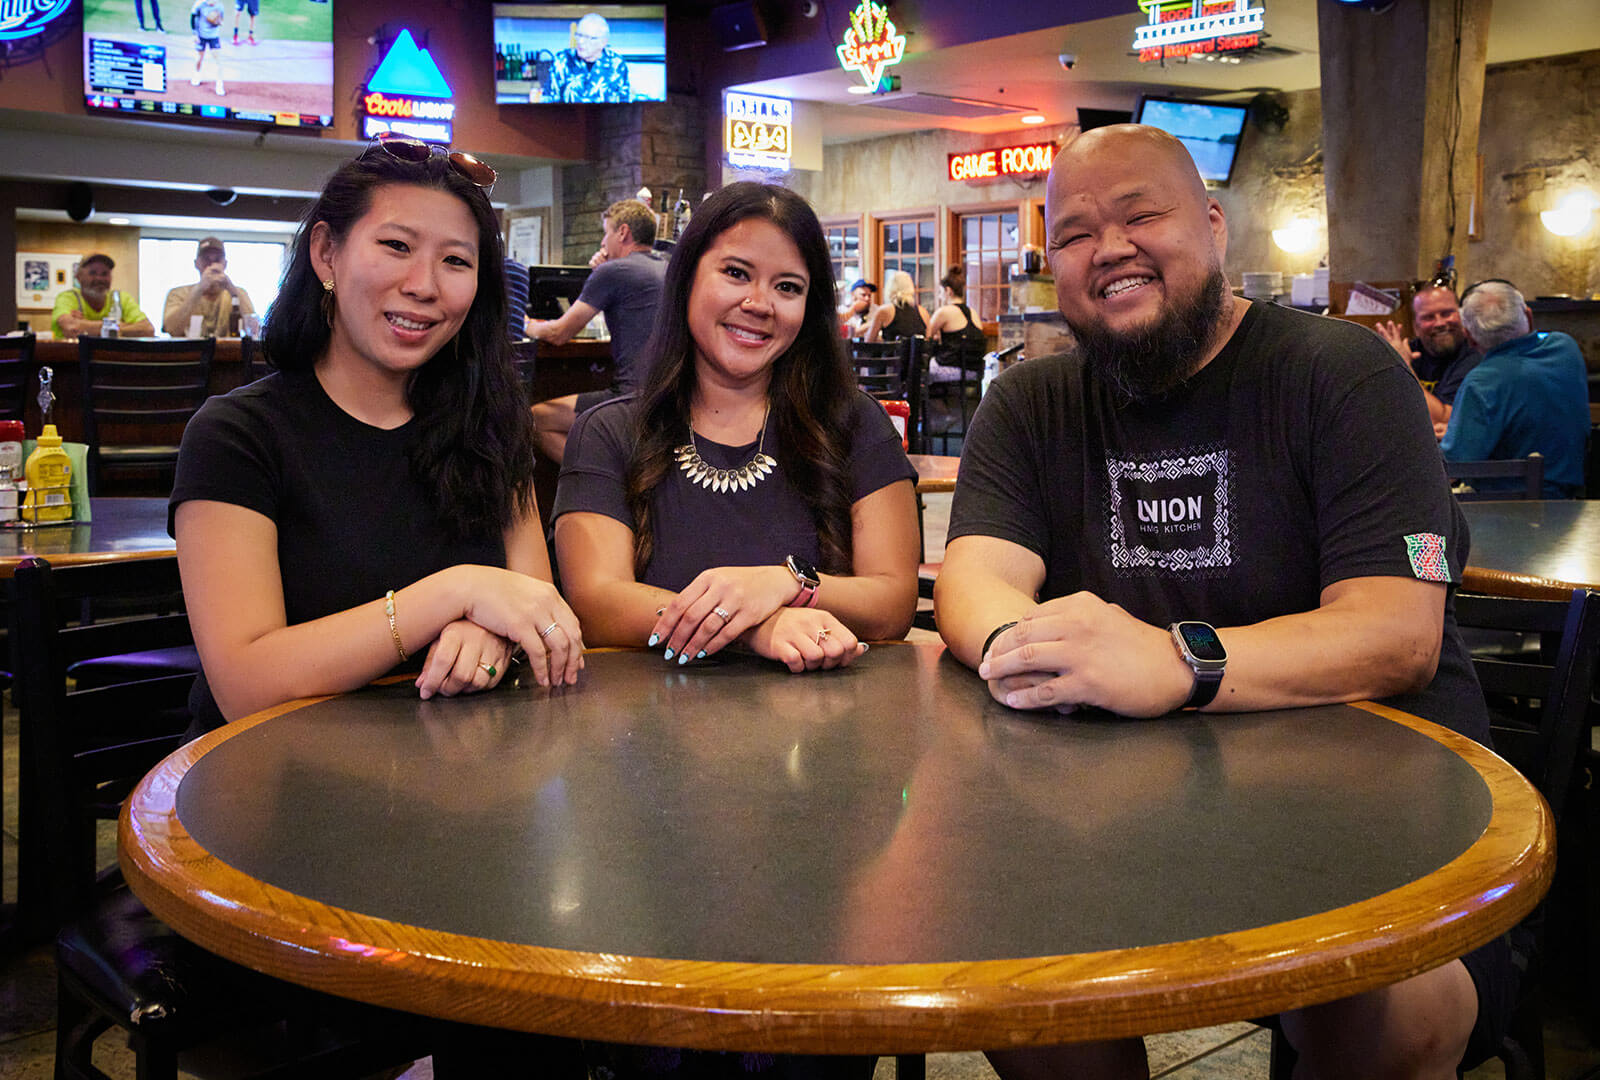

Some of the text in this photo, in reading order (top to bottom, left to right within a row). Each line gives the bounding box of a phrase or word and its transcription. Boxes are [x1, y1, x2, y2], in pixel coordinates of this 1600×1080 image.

[845, 38, 903, 65] SUMMIT
[1164, 38, 1215, 58] Inaugural
[1217, 34, 1258, 51] Season
[364, 92, 412, 117] Coors
[951, 145, 1053, 180] GAME ROOM
[1137, 495, 1202, 523] UNION
[1164, 522, 1201, 534] KITCHEN
